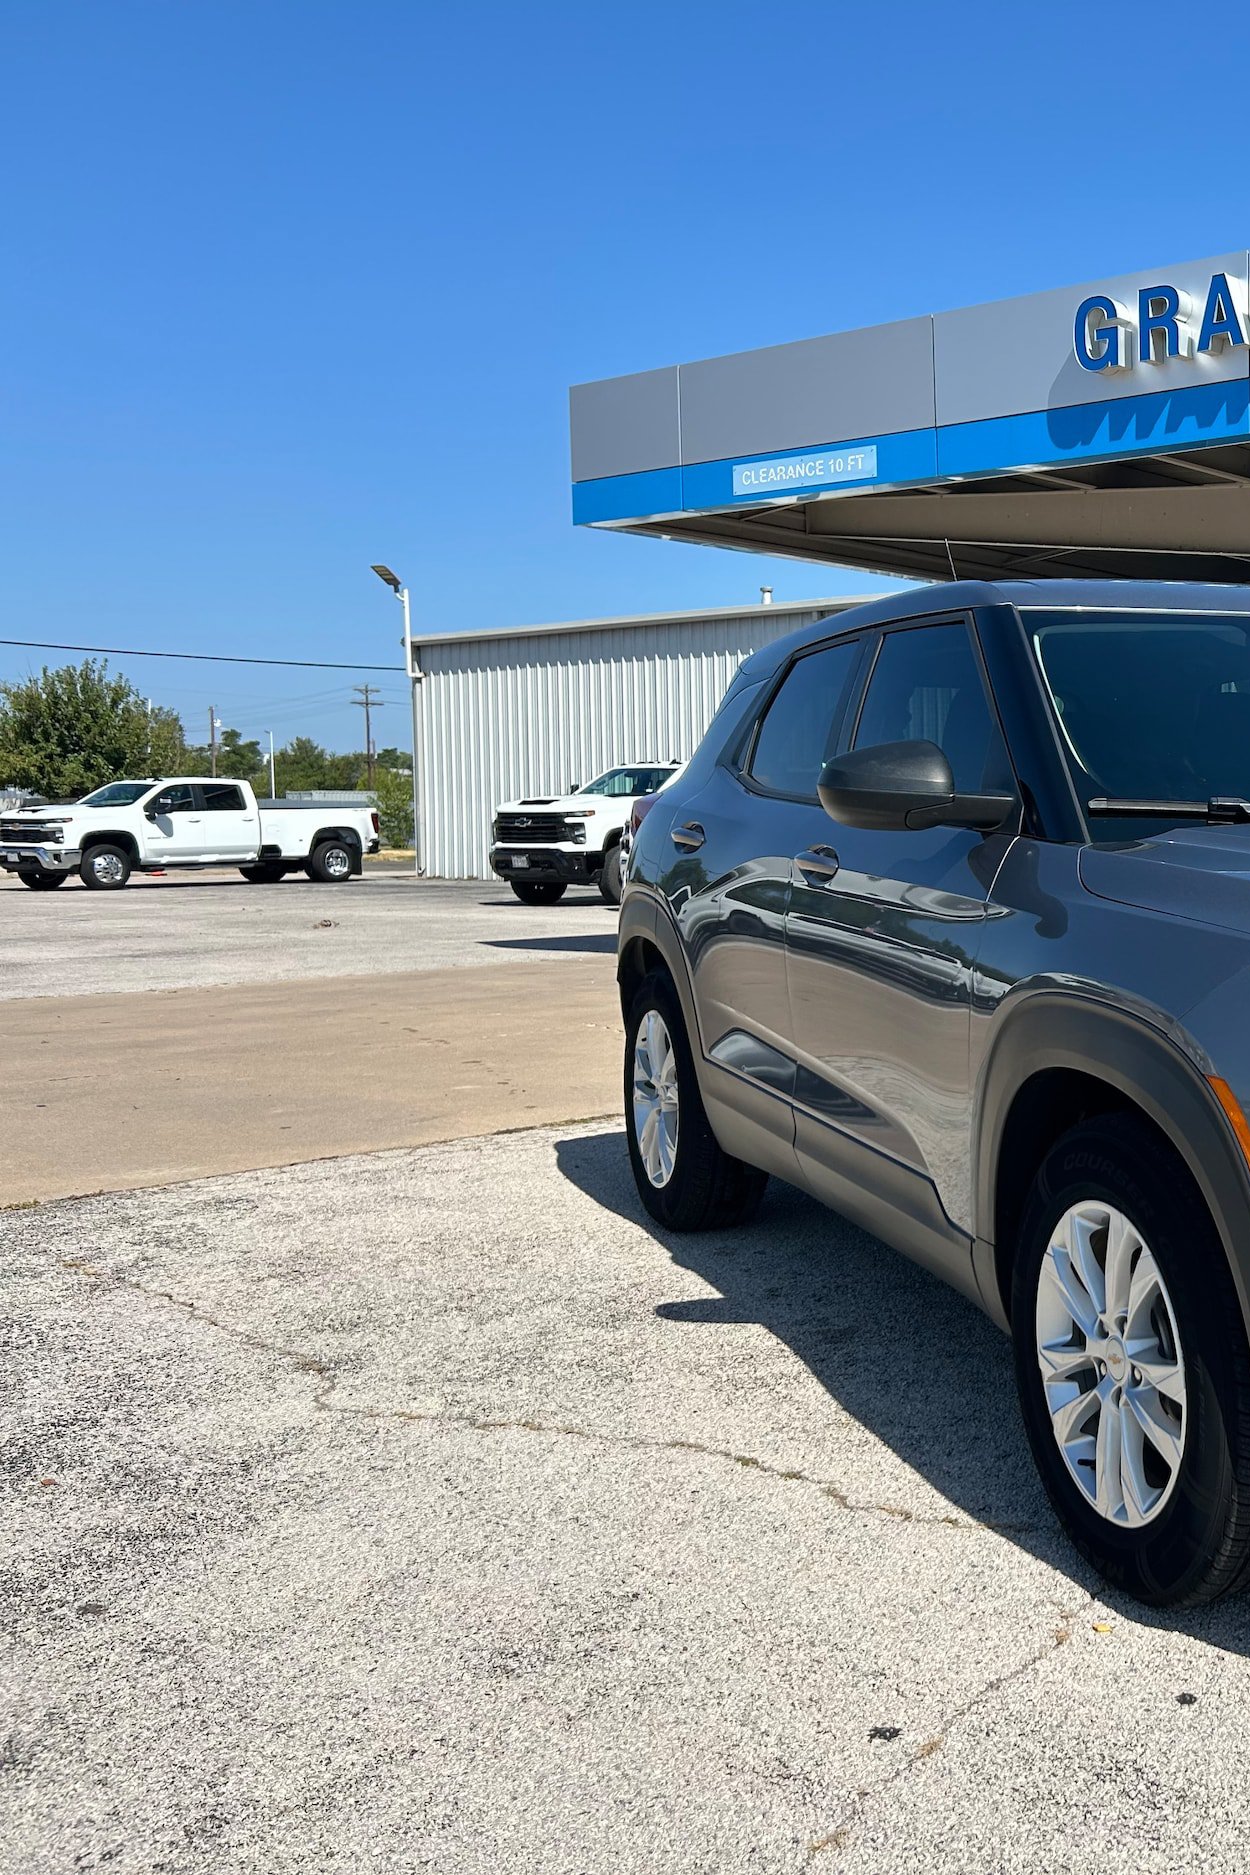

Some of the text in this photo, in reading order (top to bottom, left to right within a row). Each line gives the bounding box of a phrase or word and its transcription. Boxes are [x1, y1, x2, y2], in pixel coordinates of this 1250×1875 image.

[741, 454, 865, 487] CLEARANCE 10 FT
